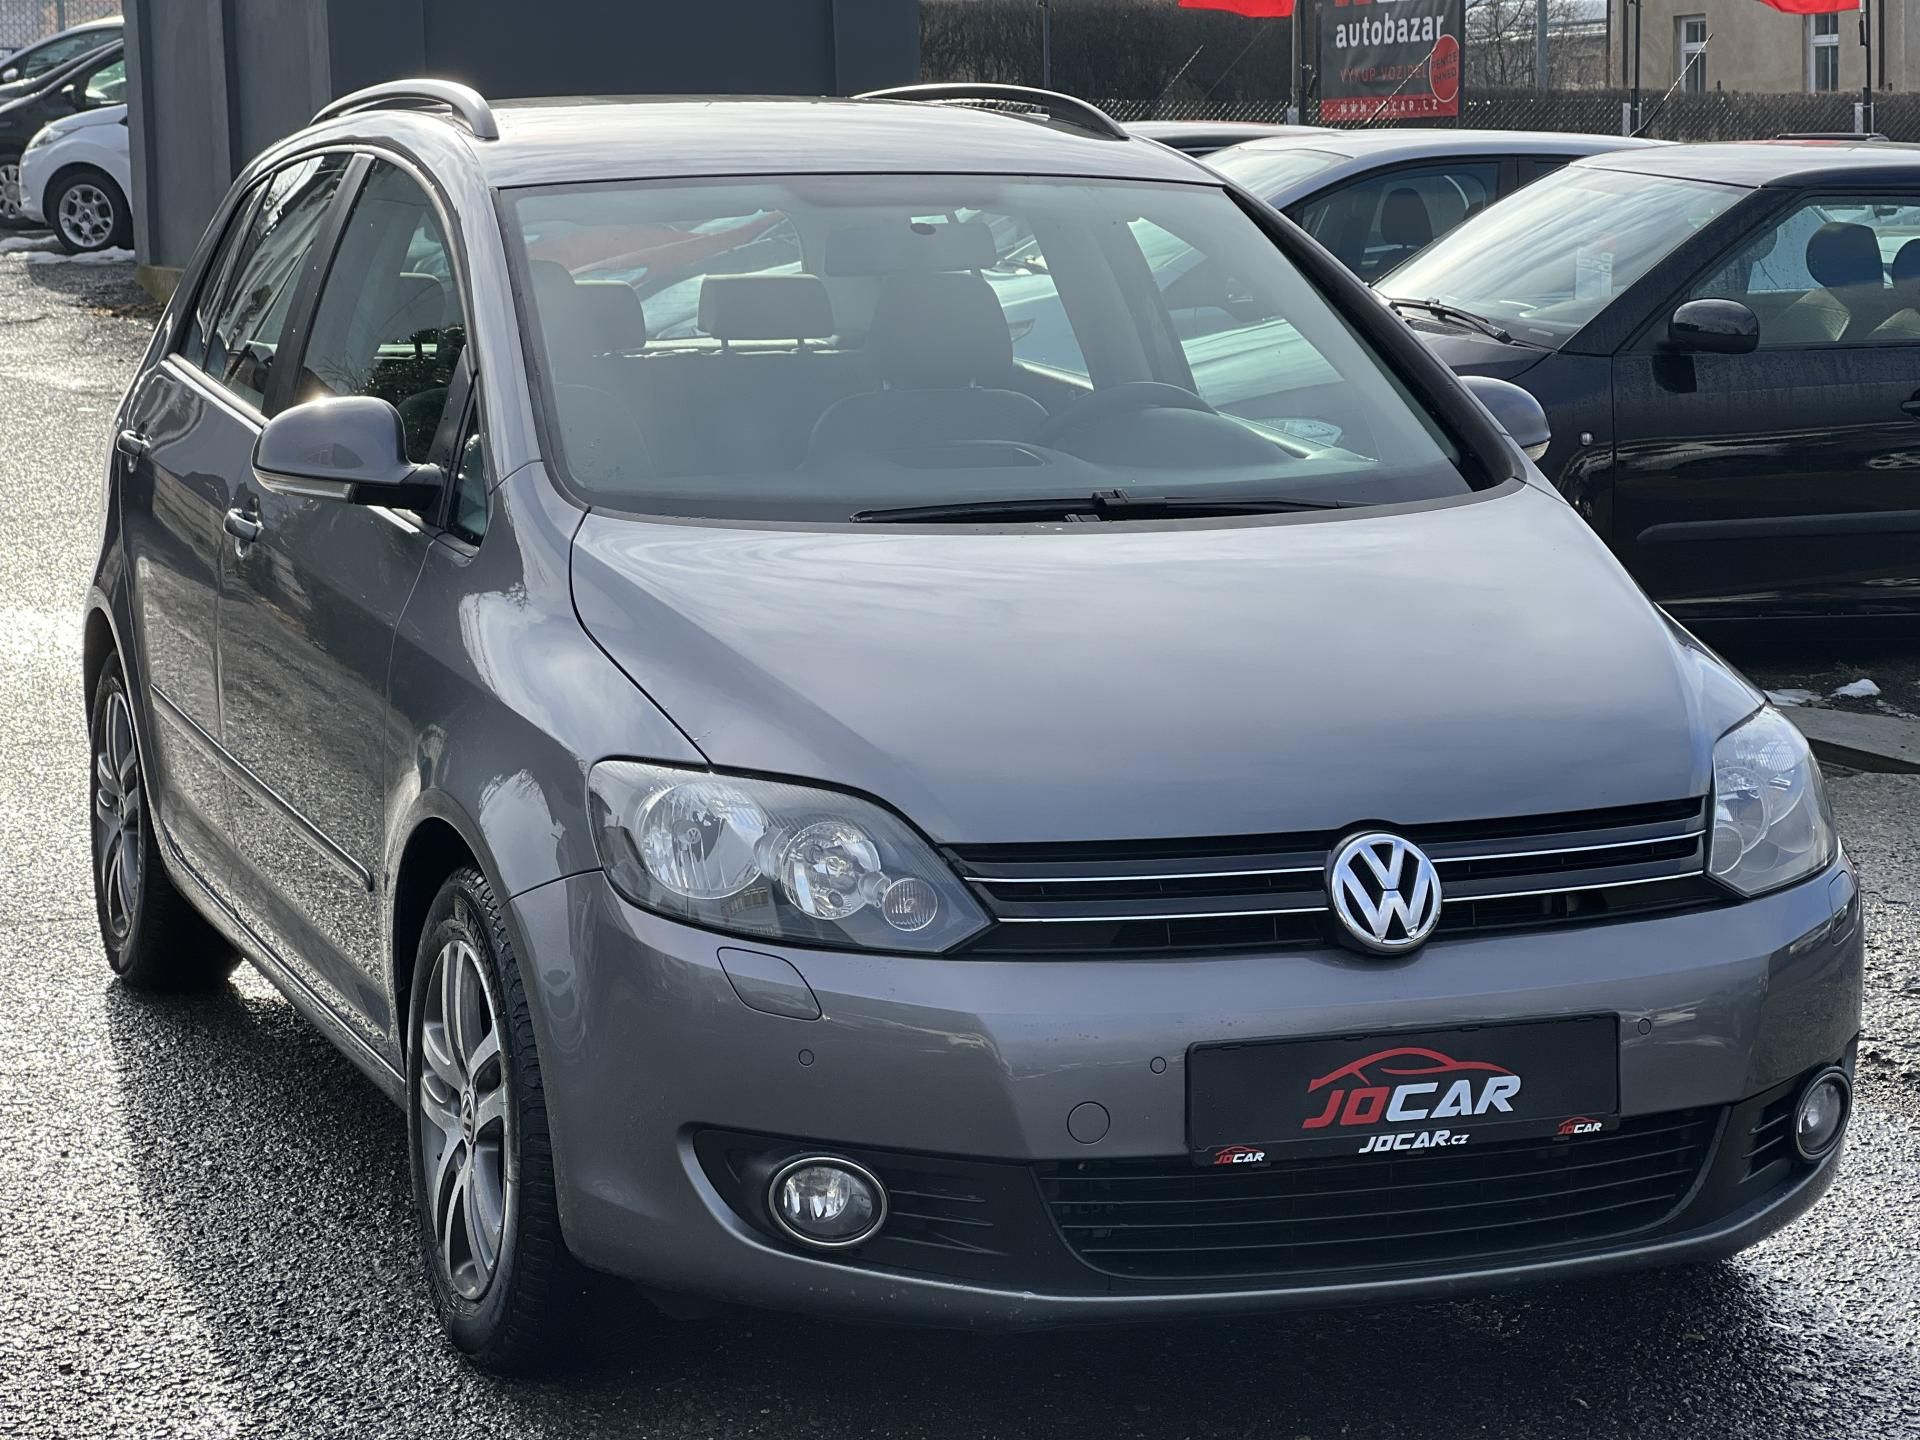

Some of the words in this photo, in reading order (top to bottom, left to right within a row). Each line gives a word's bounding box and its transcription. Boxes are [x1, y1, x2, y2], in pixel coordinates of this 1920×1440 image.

[1335, 12, 1444, 48] autobazar
[1335, 836, 1438, 946] VW
[1302, 1075, 1522, 1129] JOCAR
[1557, 1122, 1602, 1135] JOCAR
[1214, 1152, 1265, 1165] JOCAR
